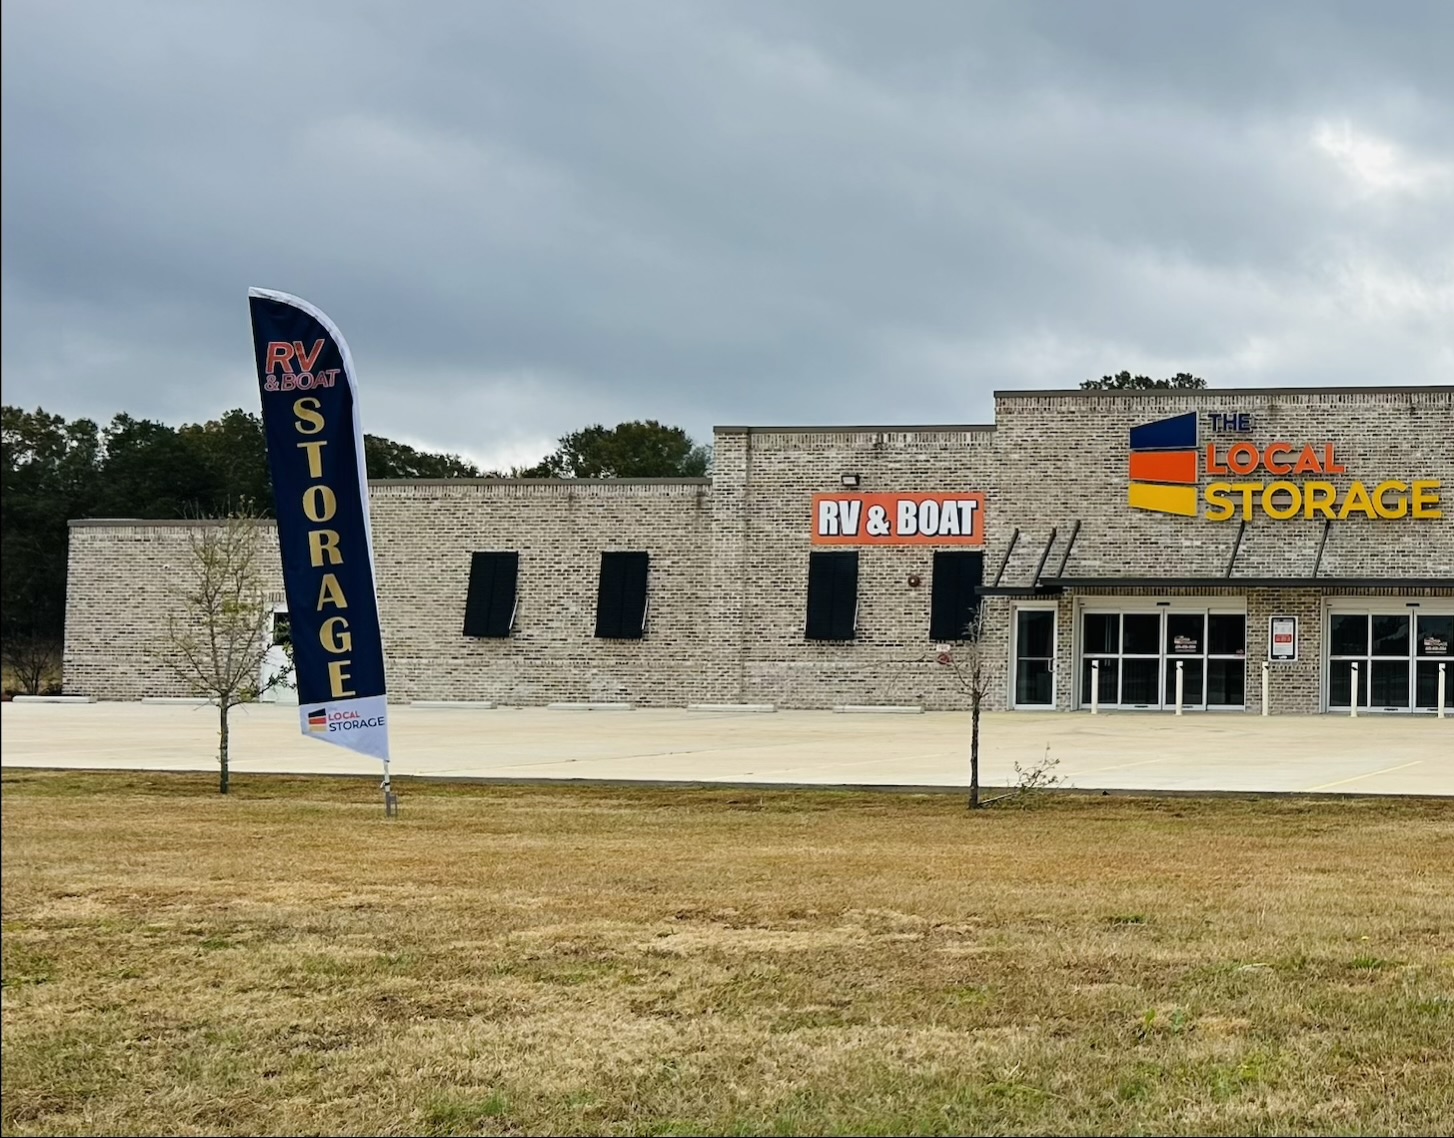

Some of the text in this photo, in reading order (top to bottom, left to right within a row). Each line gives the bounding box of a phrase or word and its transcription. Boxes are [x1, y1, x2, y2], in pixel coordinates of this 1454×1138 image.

[265, 339, 325, 374] RV
[264, 368, 341, 392] & BOAT
[1207, 413, 1251, 431] THE
[1206, 442, 1346, 475] LOCAL
[1204, 480, 1442, 521] STORAGE
[818, 499, 978, 537] RV & BOAT
[293, 396, 356, 698] STORAGE
[328, 711, 360, 720] LOCAL
[329, 716, 385, 732] STORAGE
